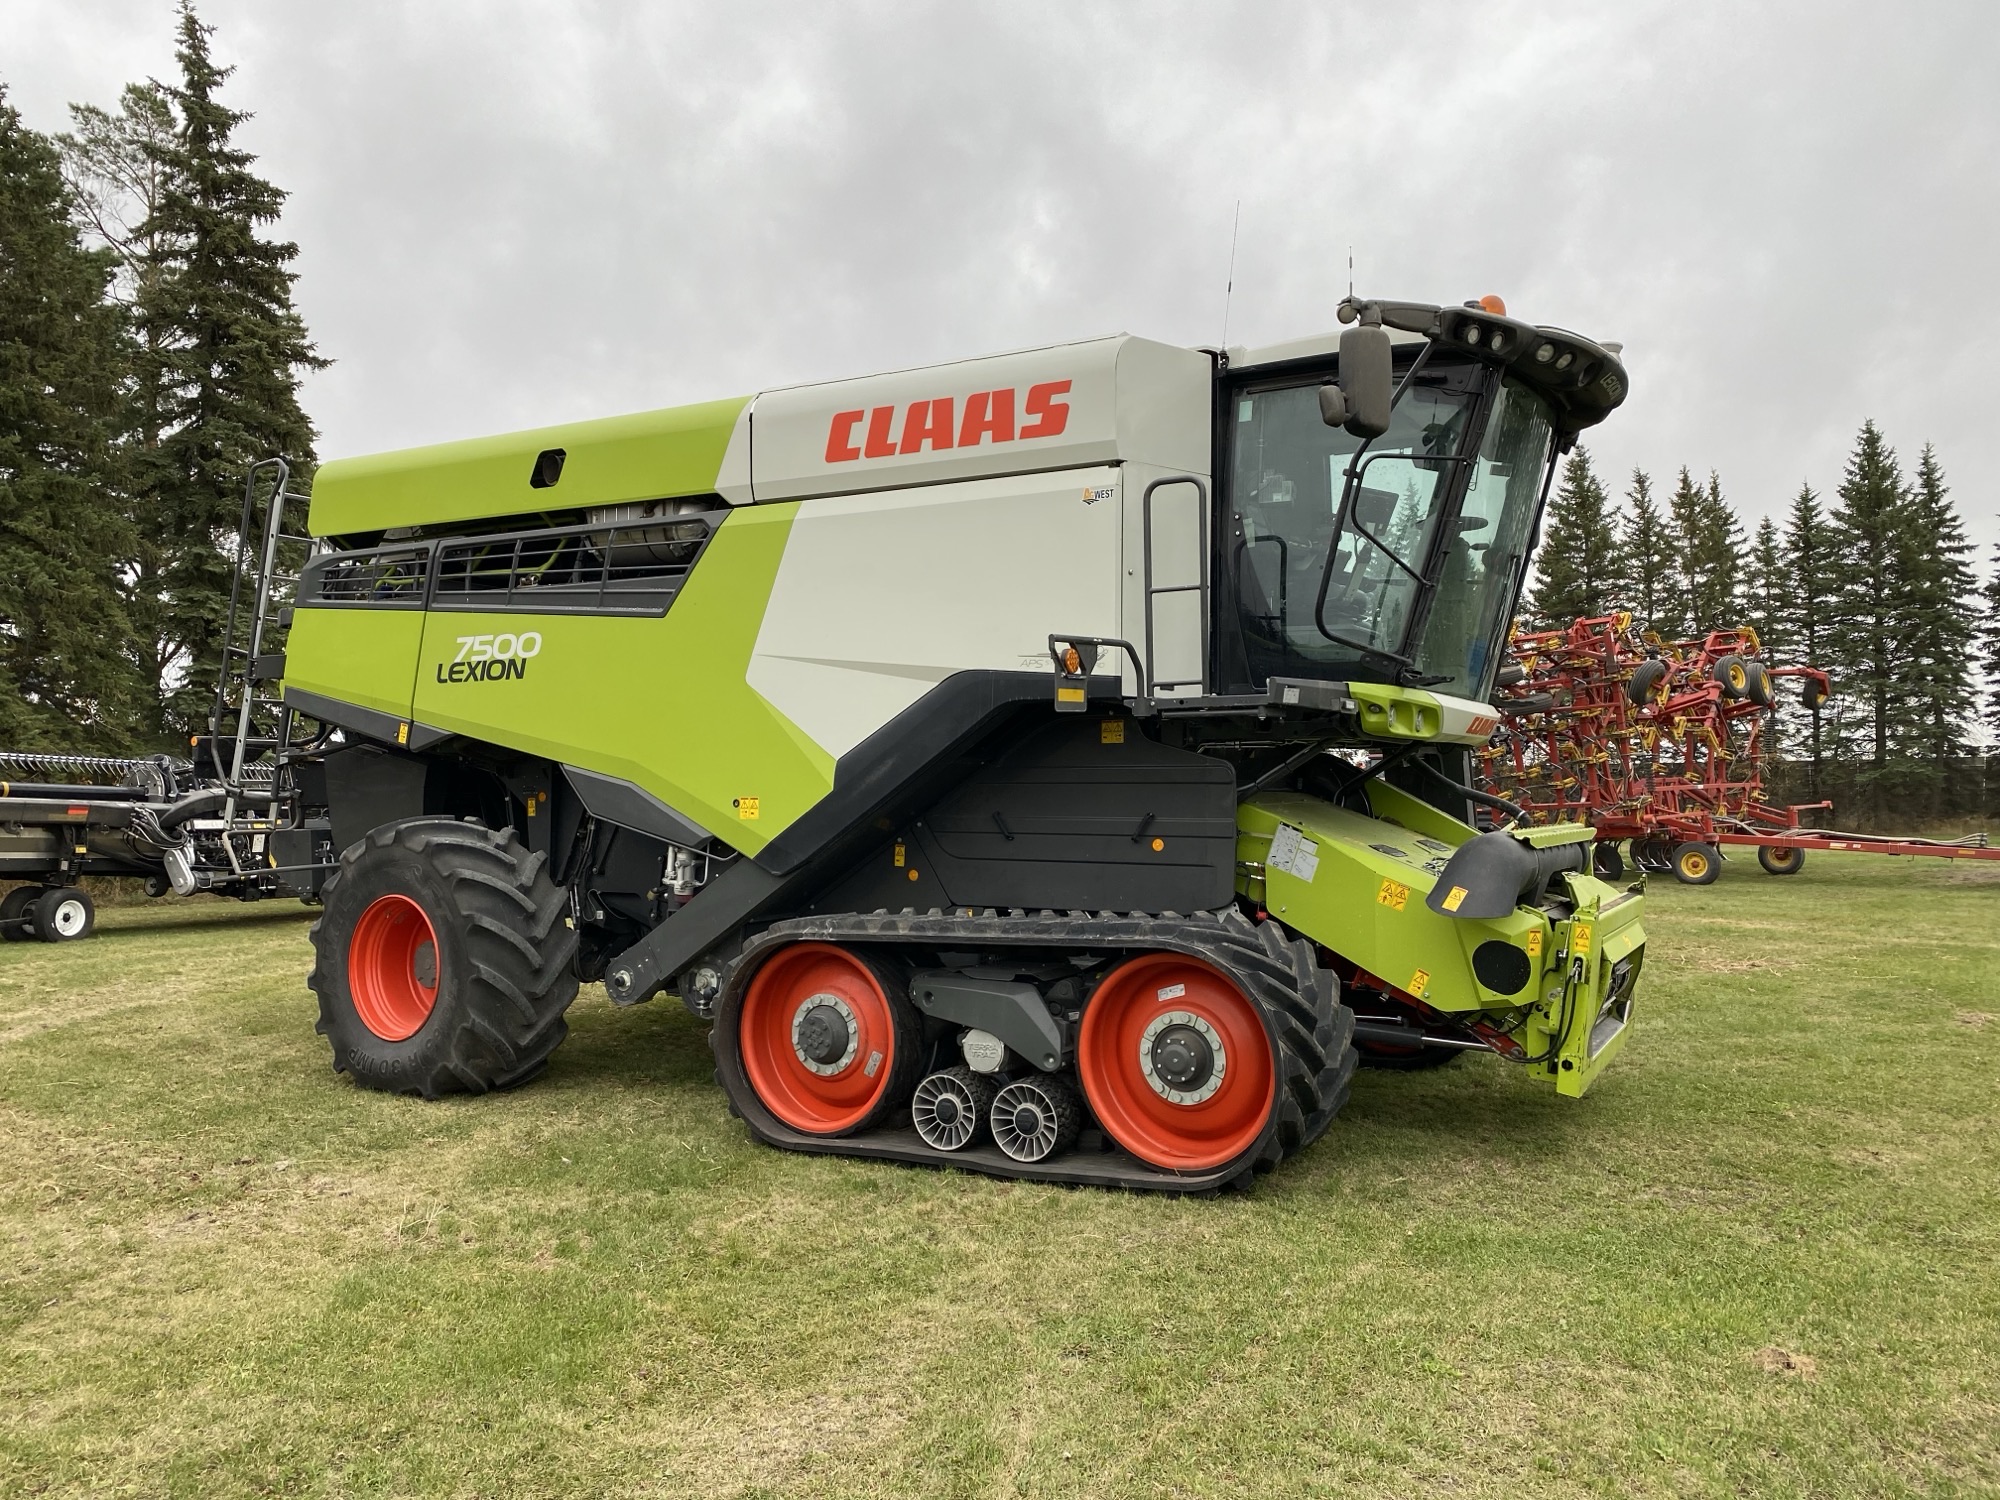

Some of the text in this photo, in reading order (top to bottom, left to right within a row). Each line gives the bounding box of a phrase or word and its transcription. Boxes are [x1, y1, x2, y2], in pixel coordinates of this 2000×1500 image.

[825, 379, 1073, 463] CLAAS
[453, 631, 543, 663] 7500
[436, 657, 527, 684] LEXION
[1019, 659, 1044, 669] APS
[1465, 716, 1498, 737] CLAAS
[967, 1043, 999, 1052] TERRA
[971, 1051, 997, 1059] TRAC
